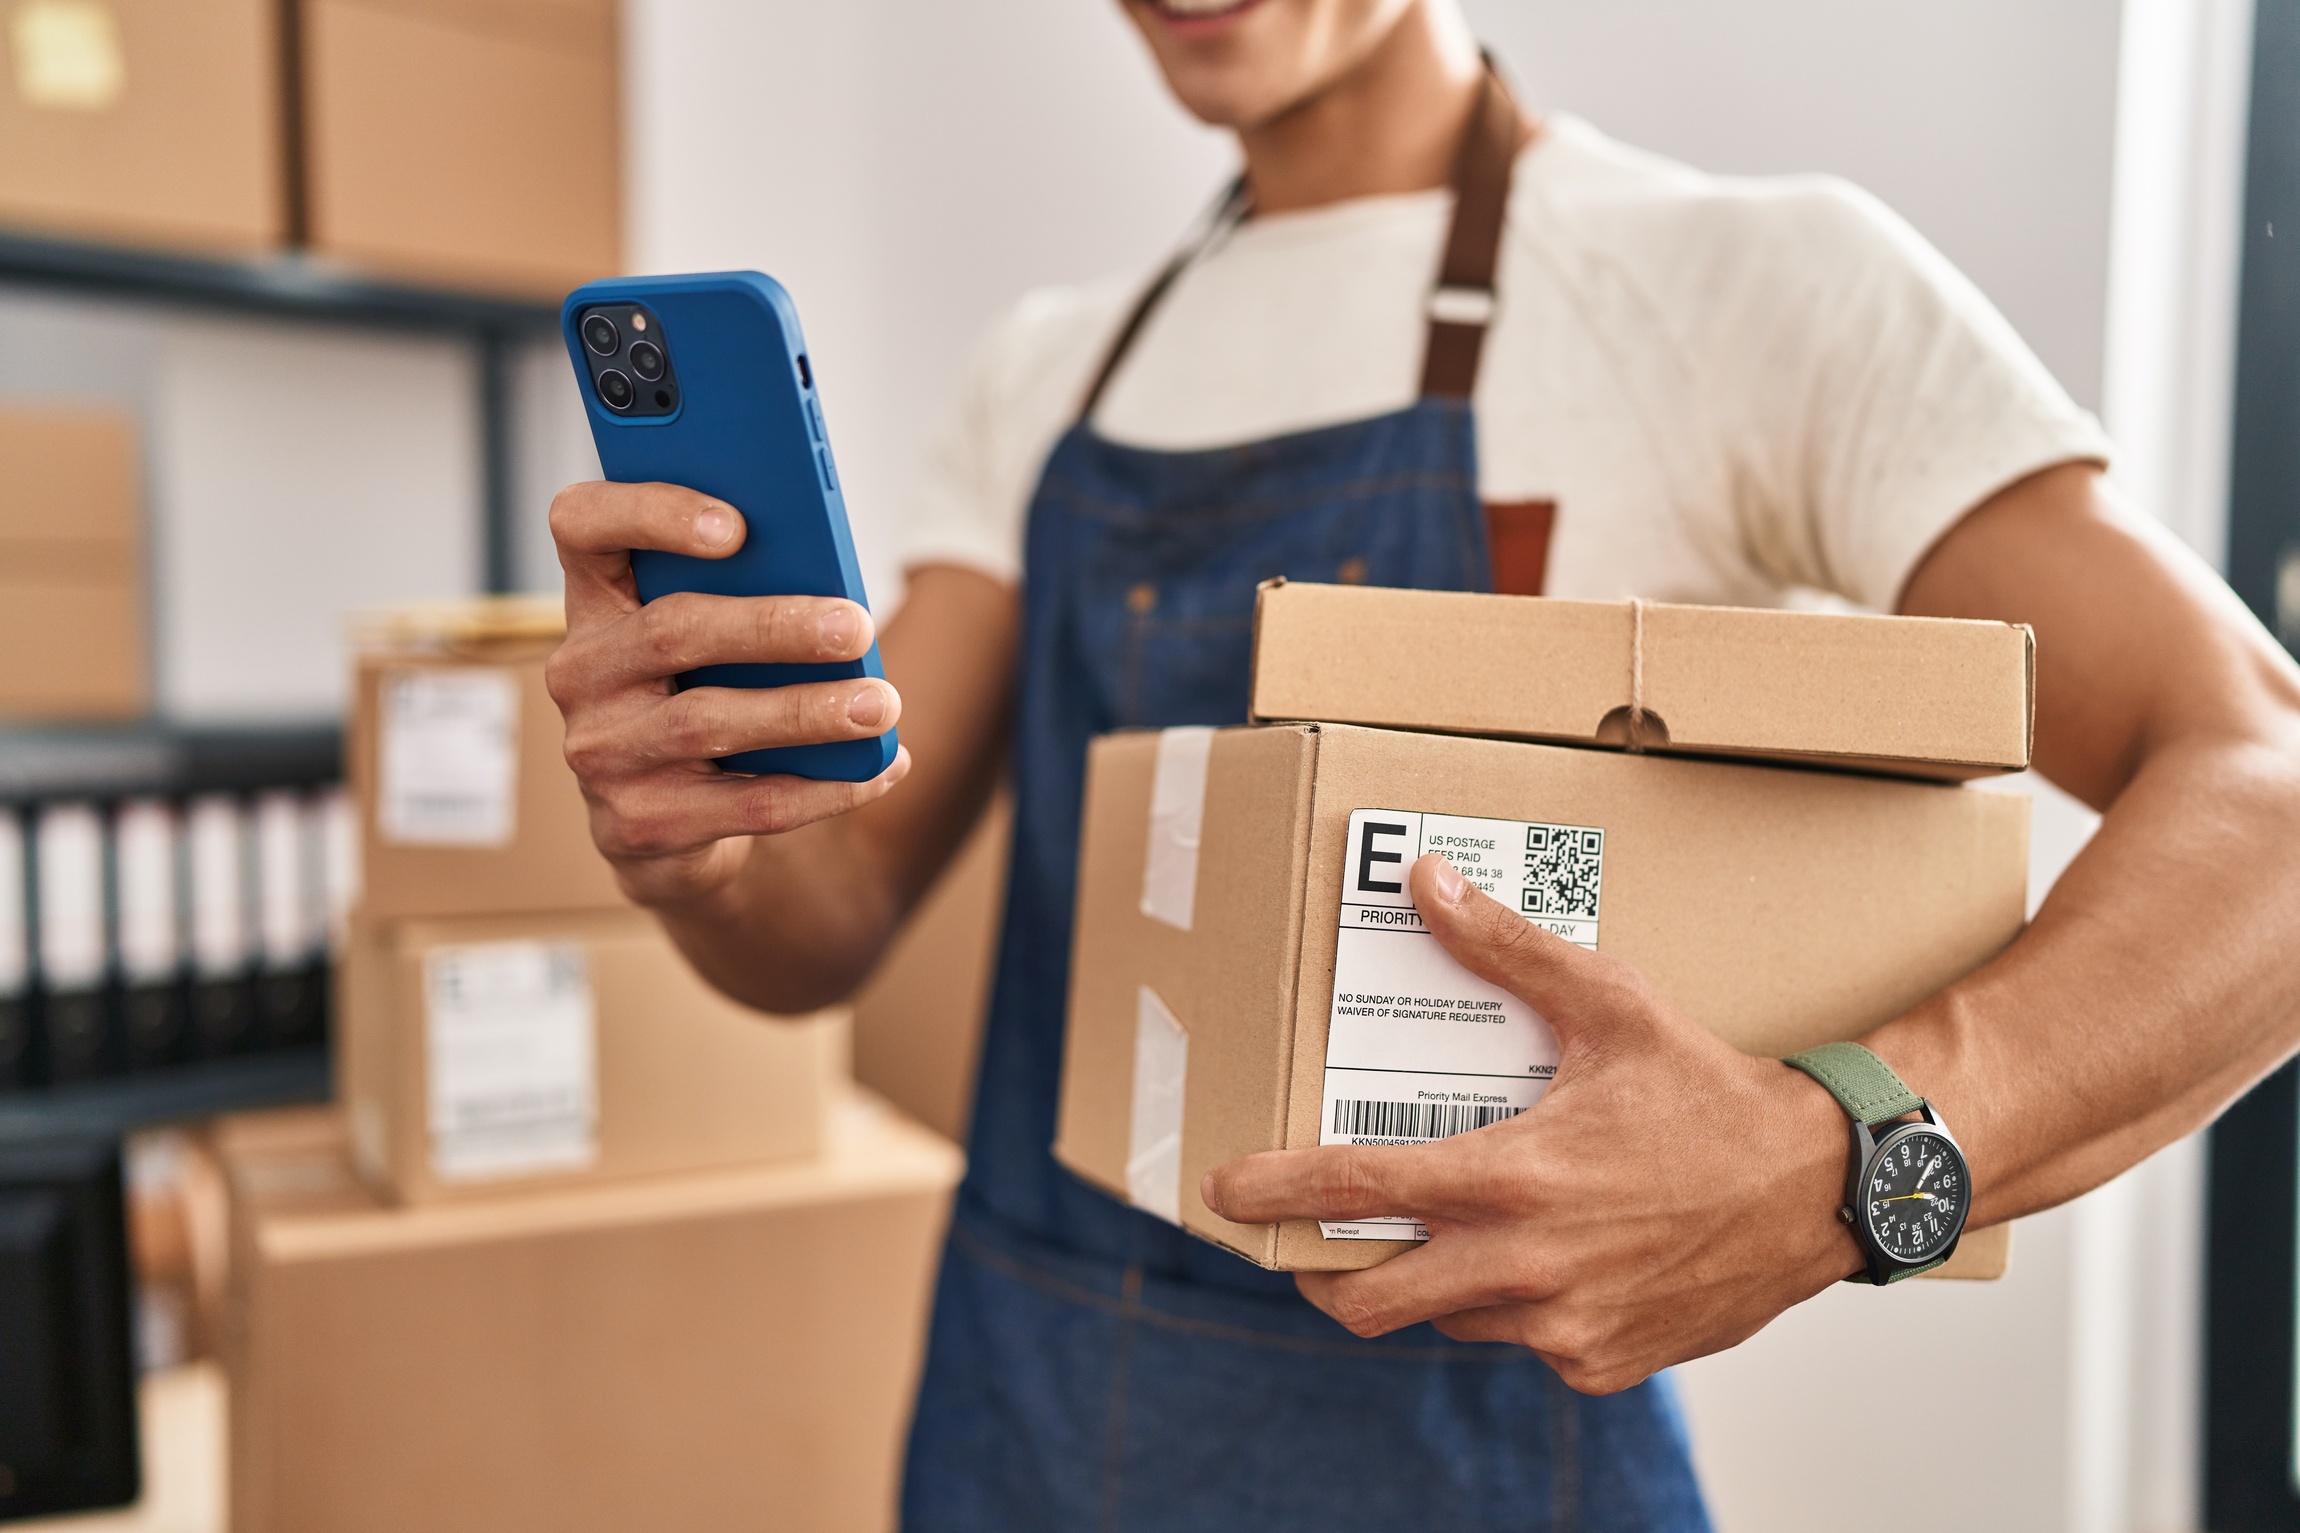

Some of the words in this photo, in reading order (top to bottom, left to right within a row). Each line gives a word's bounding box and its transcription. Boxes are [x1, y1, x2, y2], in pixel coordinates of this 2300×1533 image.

[1429, 835, 1444, 846] US
[1446, 836, 1496, 850] POSTAGE
[1357, 821, 1407, 894] E
[1456, 851, 1481, 863] PAID
[1461, 866, 1474, 877] 68
[1476, 867, 1488, 877] 94
[1490, 868, 1503, 879] 38
[1360, 909, 1423, 927] PRIORITY
[1550, 923, 1576, 936] DAY
[1338, 993, 1354, 1003] NO
[1355, 994, 1395, 1005] SUNDAY
[1397, 996, 1412, 1006] OR
[1413, 997, 1455, 1009] HOLIDAY
[1457, 1000, 1503, 1011] DELIVERY
[1337, 1006, 1375, 1017] WAIVER
[1376, 1008, 1391, 1018] OF
[1392, 1009, 1447, 1021] SIGNATURE
[1448, 1012, 1506, 1024] REQUESTED
[1417, 1090, 1450, 1103] Priority
[1452, 1092, 1471, 1102] Mail
[1473, 1093, 1508, 1104] Express
[1901, 1145, 1910, 1158] 6
[1920, 1145, 1928, 1158] 7
[1884, 1157, 1894, 1171] 5
[1934, 1155, 1942, 1168] 8
[1874, 1179, 1883, 1192] 4
[1943, 1175, 1951, 1188] 9
[1871, 1201, 1880, 1216] 3
[1938, 1197, 1949, 1213] 10
[1336, 1227, 1360, 1235] Receipt
[1881, 1222, 1890, 1236] 2
[1930, 1218, 1938, 1233] 11
[1912, 1230, 1923, 1244] 12
